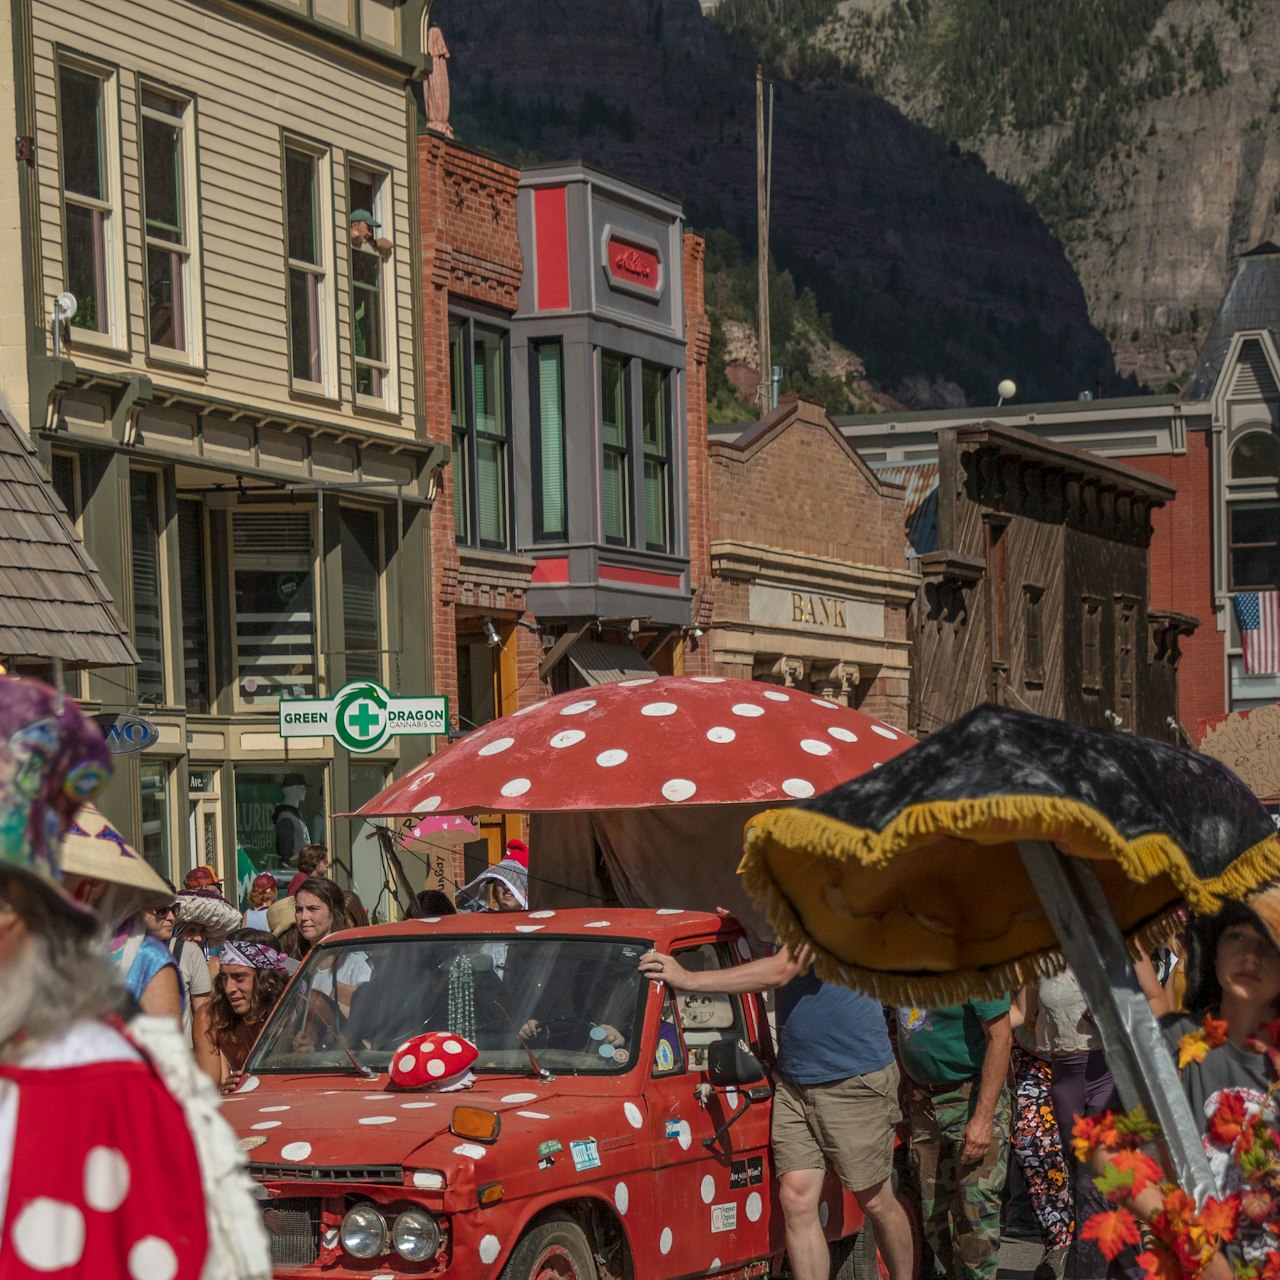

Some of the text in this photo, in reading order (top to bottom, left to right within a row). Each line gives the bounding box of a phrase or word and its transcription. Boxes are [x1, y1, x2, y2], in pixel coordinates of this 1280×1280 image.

[791, 591, 847, 628] BANK
[284, 712, 328, 724] GREEN
[388, 710, 444, 721] DRAGON
[389, 719, 443, 729] CANNABIS CO.
[190, 775, 204, 788] Ave.
